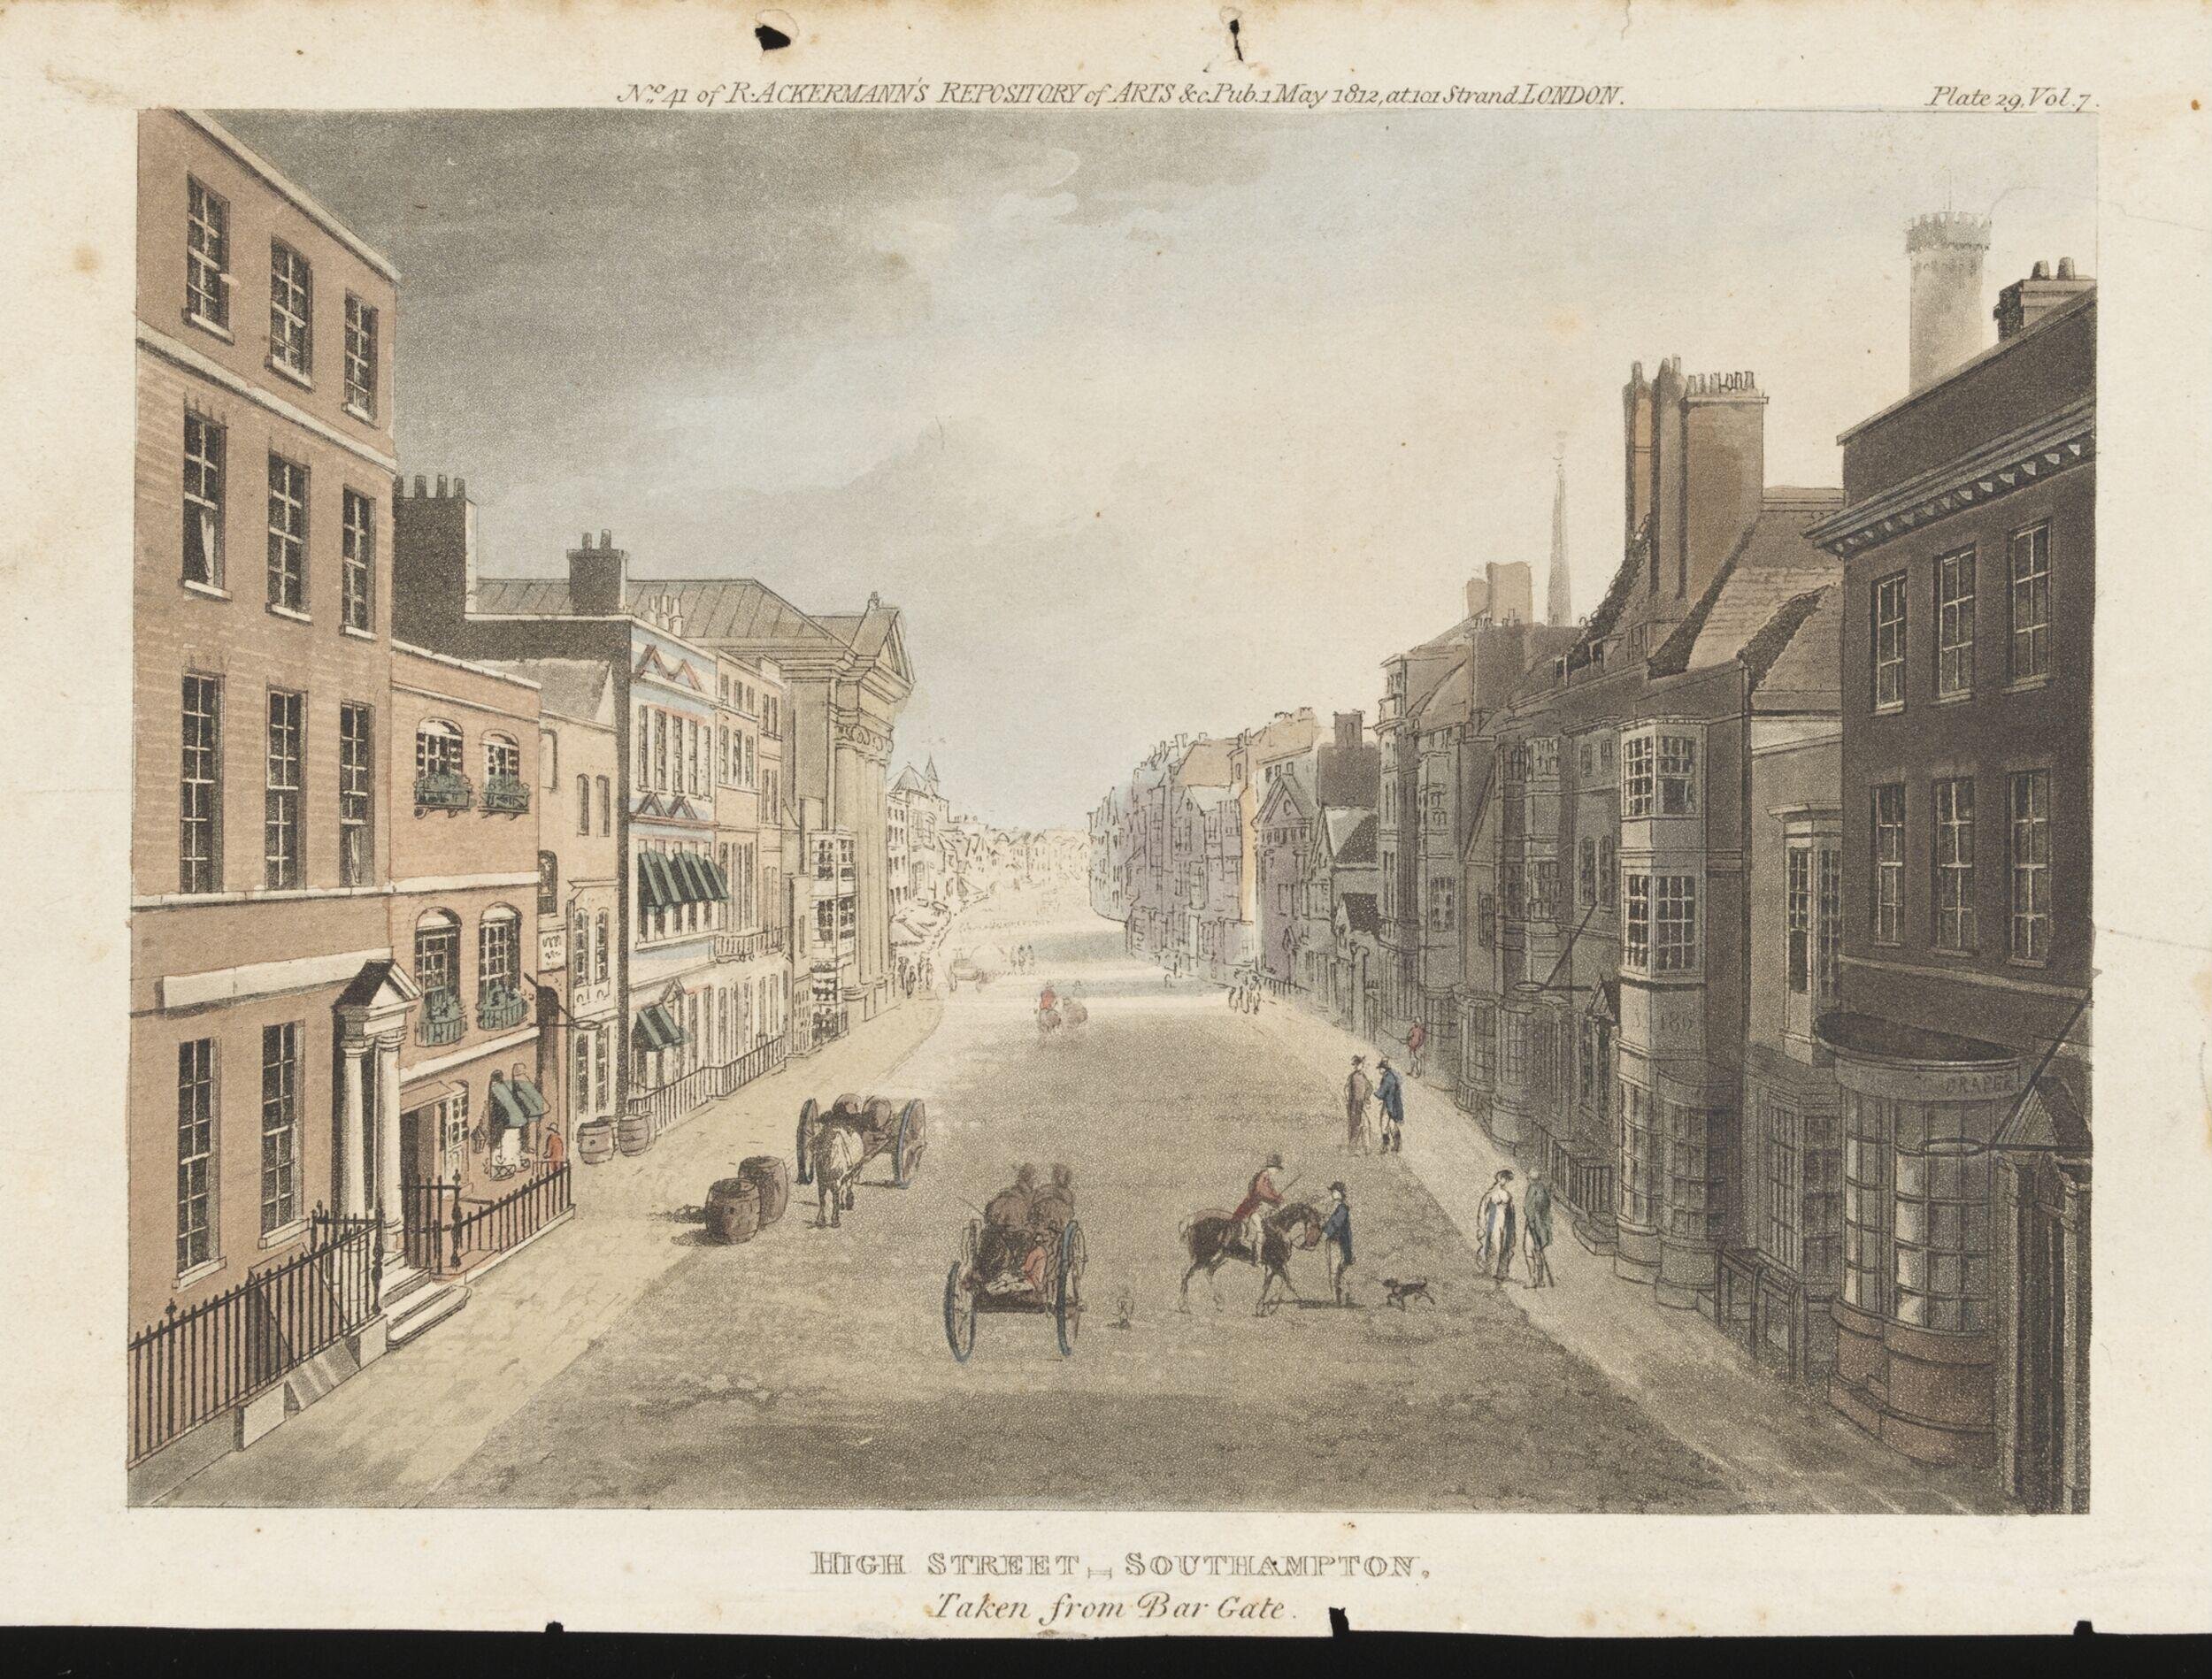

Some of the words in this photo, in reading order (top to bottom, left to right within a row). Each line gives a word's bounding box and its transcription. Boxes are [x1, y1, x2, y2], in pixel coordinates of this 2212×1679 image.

[662, 88, 688, 110] 41
[696, 83, 726, 108] of
[936, 81, 1087, 104] REPOSITORY
[1084, 84, 1112, 107] of
[1107, 80, 1177, 104] ARTS
[1272, 83, 1328, 109] May
[1442, 84, 1520, 104] Strand
[1517, 82, 1624, 105] LONDON.
[1924, 86, 1992, 107] Plate
[809, 1551, 907, 1576] HIGH
[927, 1552, 1080, 1576] STREET
[927, 1592, 1031, 1619] Taken
[1038, 1591, 1127, 1627] from
[1136, 1591, 1210, 1619] Bar
[1217, 1595, 1297, 1620] Gate.
